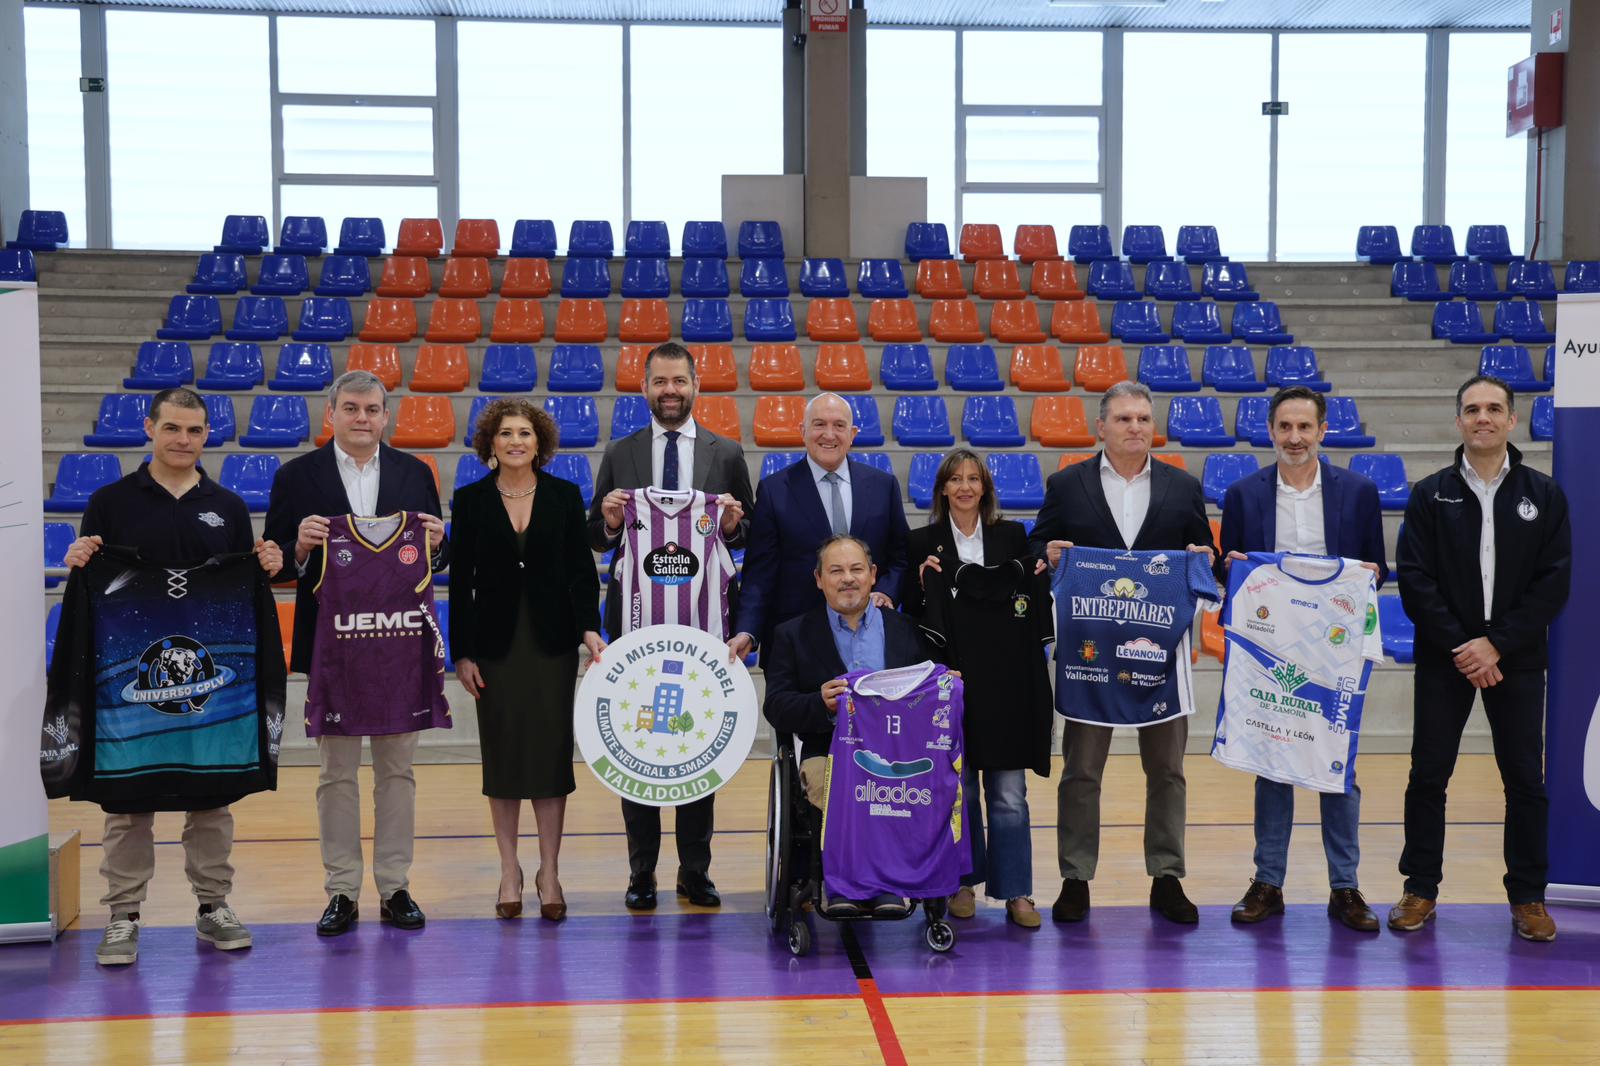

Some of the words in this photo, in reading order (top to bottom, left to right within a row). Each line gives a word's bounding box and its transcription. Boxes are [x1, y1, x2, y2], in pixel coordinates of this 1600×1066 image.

[1564, 338, 1600, 358] Ayu
[652, 554, 691, 564] Estrella
[653, 564, 689, 574] Galicia
[334, 610, 423, 631] UEMC
[1071, 596, 1175, 625] ENTREPINARES
[336, 630, 423, 639] UNIVERSIDAD
[1246, 622, 1275, 634] Valladolid
[1117, 646, 1165, 660] LEVANOVA
[605, 662, 625, 684] EU
[625, 640, 698, 665] MISSION
[699, 651, 735, 698] LABEL
[1065, 670, 1109, 683] Valladolid
[133, 687, 192, 701] UNIVERSO
[195, 675, 225, 693] CPLV
[1249, 688, 1278, 703] CAJA
[1280, 695, 1321, 714] RURAL
[1259, 701, 1271, 710] DE
[1272, 705, 1306, 719] ZAMORA
[1333, 677, 1356, 735] UEMC
[886, 715, 901, 734] 13
[1245, 718, 1282, 734] CASTILLA
[1285, 729, 1291, 737] Y
[1293, 731, 1315, 742] LEÓN
[598, 702, 665, 777] CLIMATE-NEUTRAL
[668, 766, 678, 777] &
[678, 747, 716, 775] SMART
[714, 716, 735, 750] CITIES
[603, 766, 711, 800] VALLADOLID
[855, 779, 932, 805] aliados
